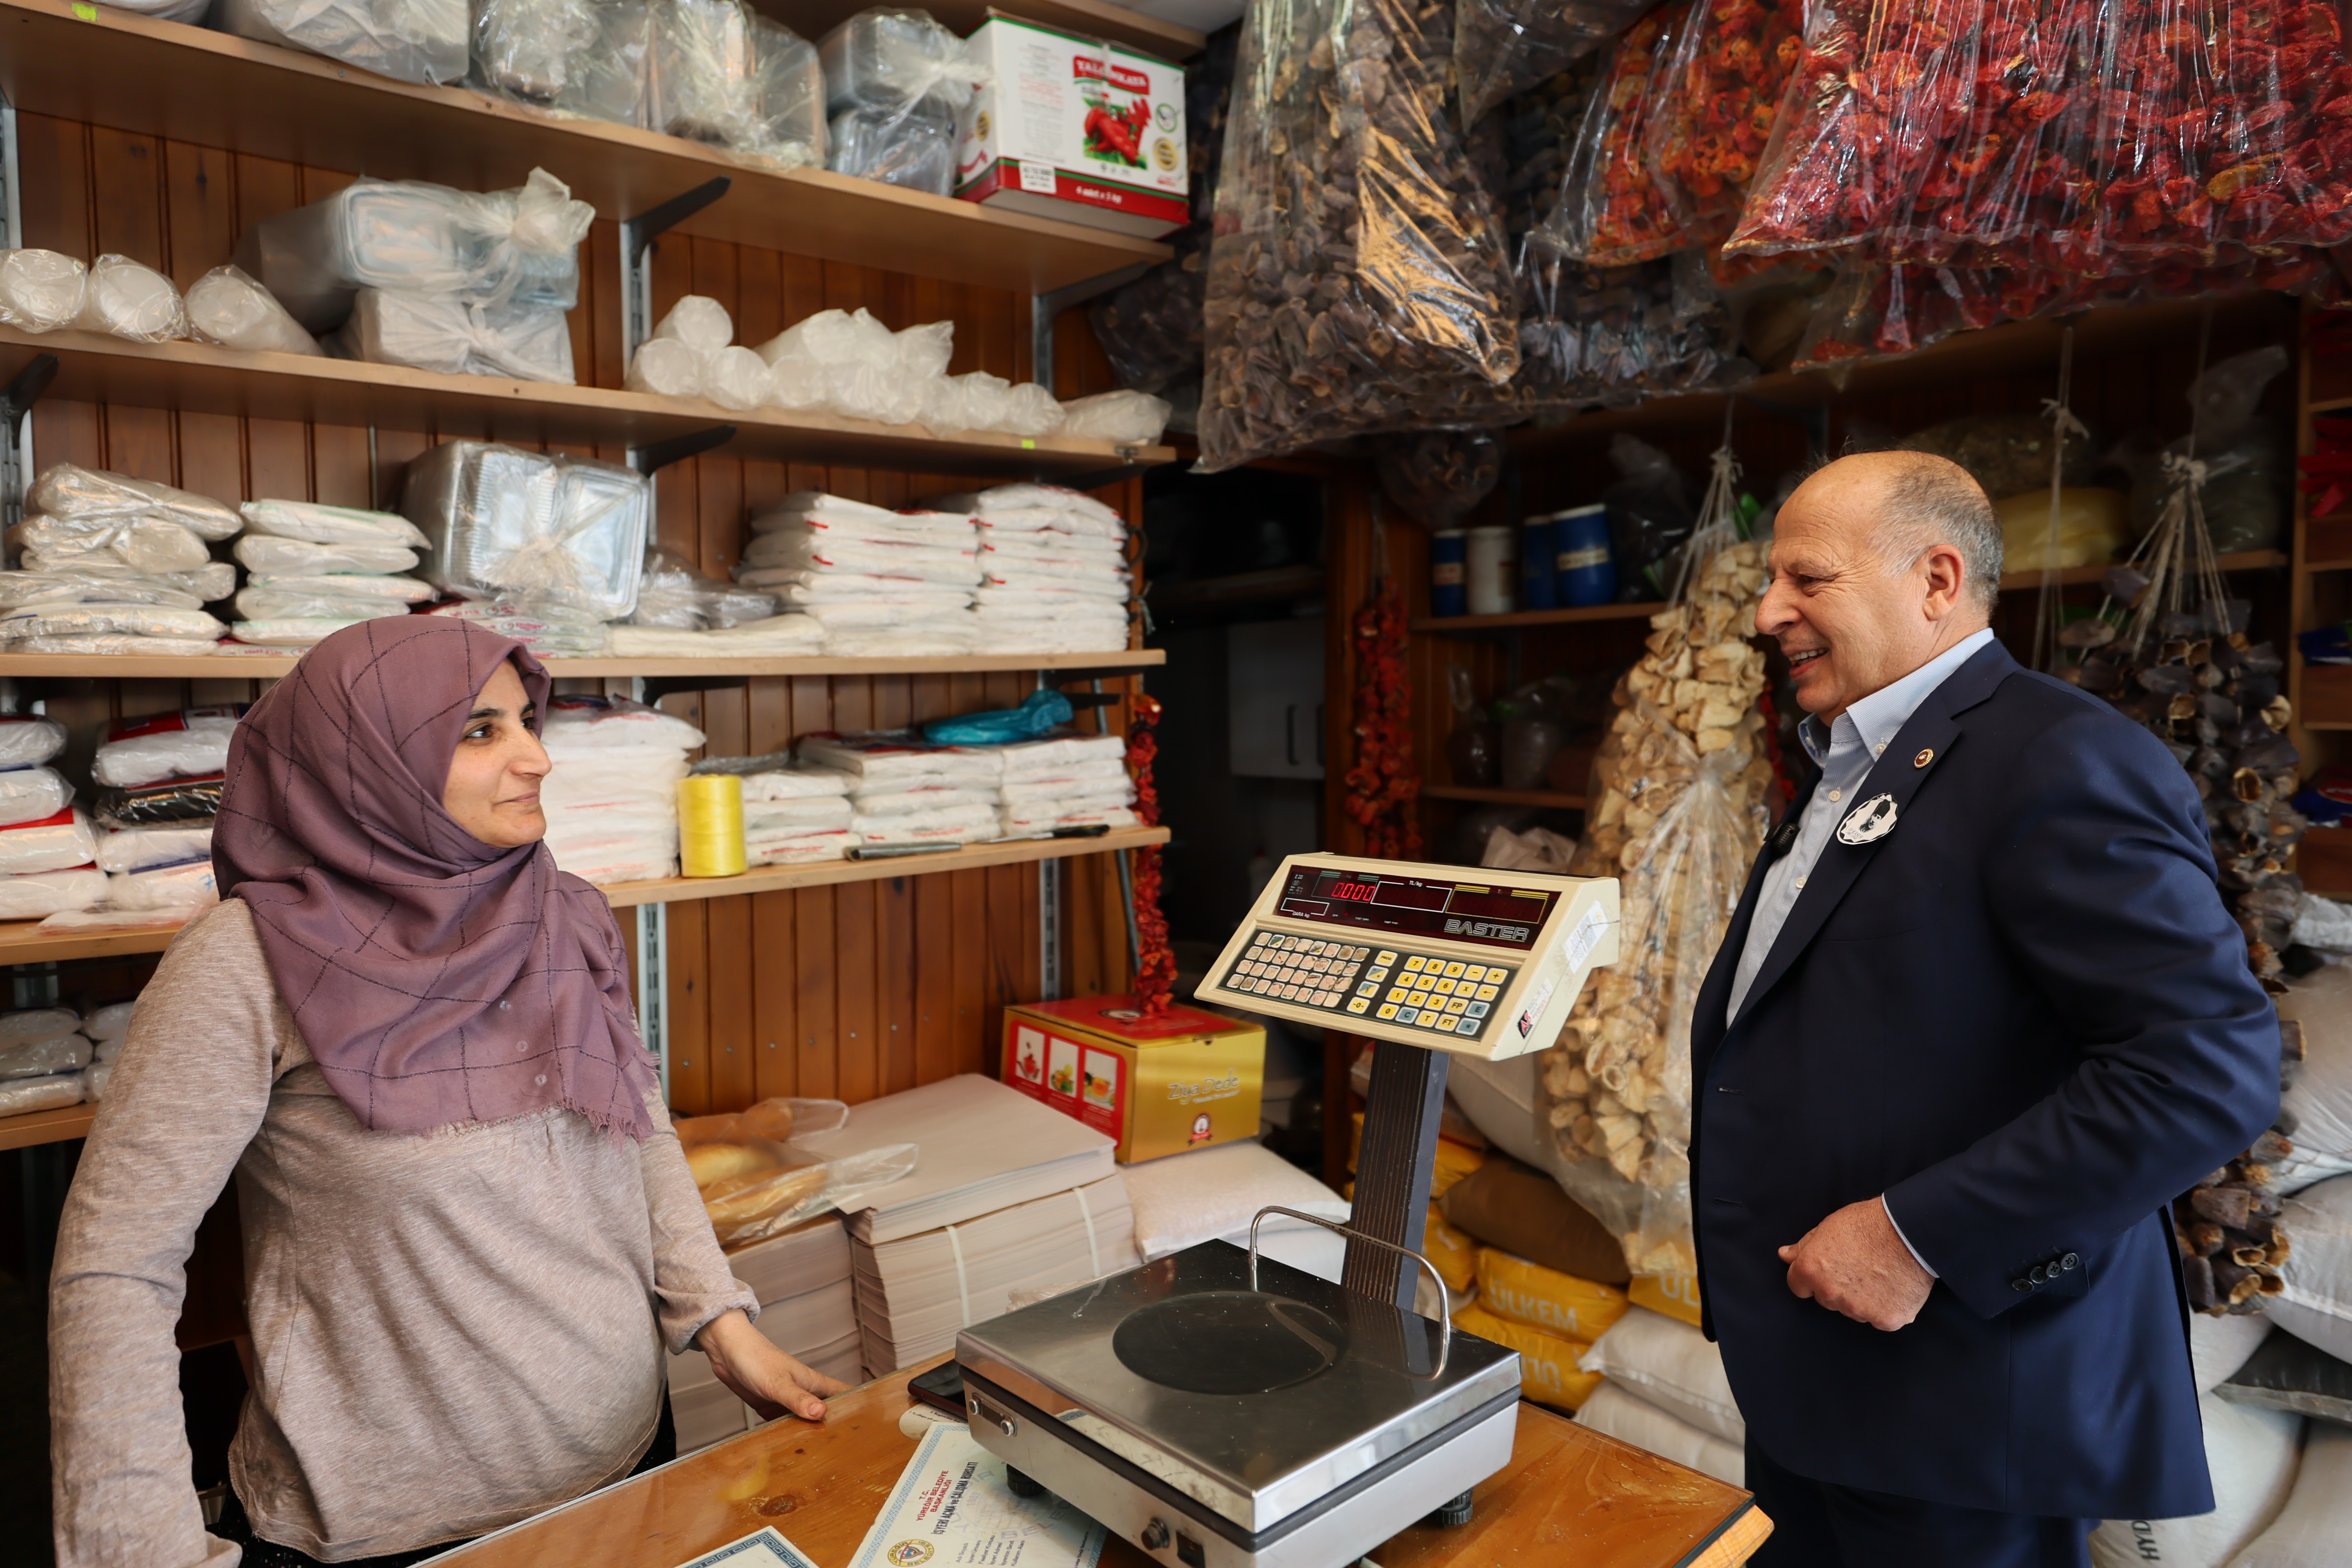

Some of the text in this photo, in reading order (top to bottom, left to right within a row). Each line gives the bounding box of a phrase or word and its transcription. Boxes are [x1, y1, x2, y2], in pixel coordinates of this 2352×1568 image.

[1444, 919, 1529, 940] BASTER
[1167, 1080, 1200, 1105] Ziya
[1203, 1069, 1240, 1093] Dede
[1490, 1279, 1578, 1333] ÜLKEM
[960, 1461, 979, 1481] RUHSATI
[916, 1470, 949, 1521] YÜREĞİR BELEDİYE
[919, 1490, 930, 1500] T.C.
[930, 1479, 953, 1513] BAŞKANLIĞI
[953, 1479, 969, 1499] ÇALIŞMA
[966, 1492, 980, 1507] 1989
[942, 1505, 956, 1519] AÇMA
[931, 1519, 949, 1535] İŞYERİ
[985, 1535, 995, 1550] Konusu
